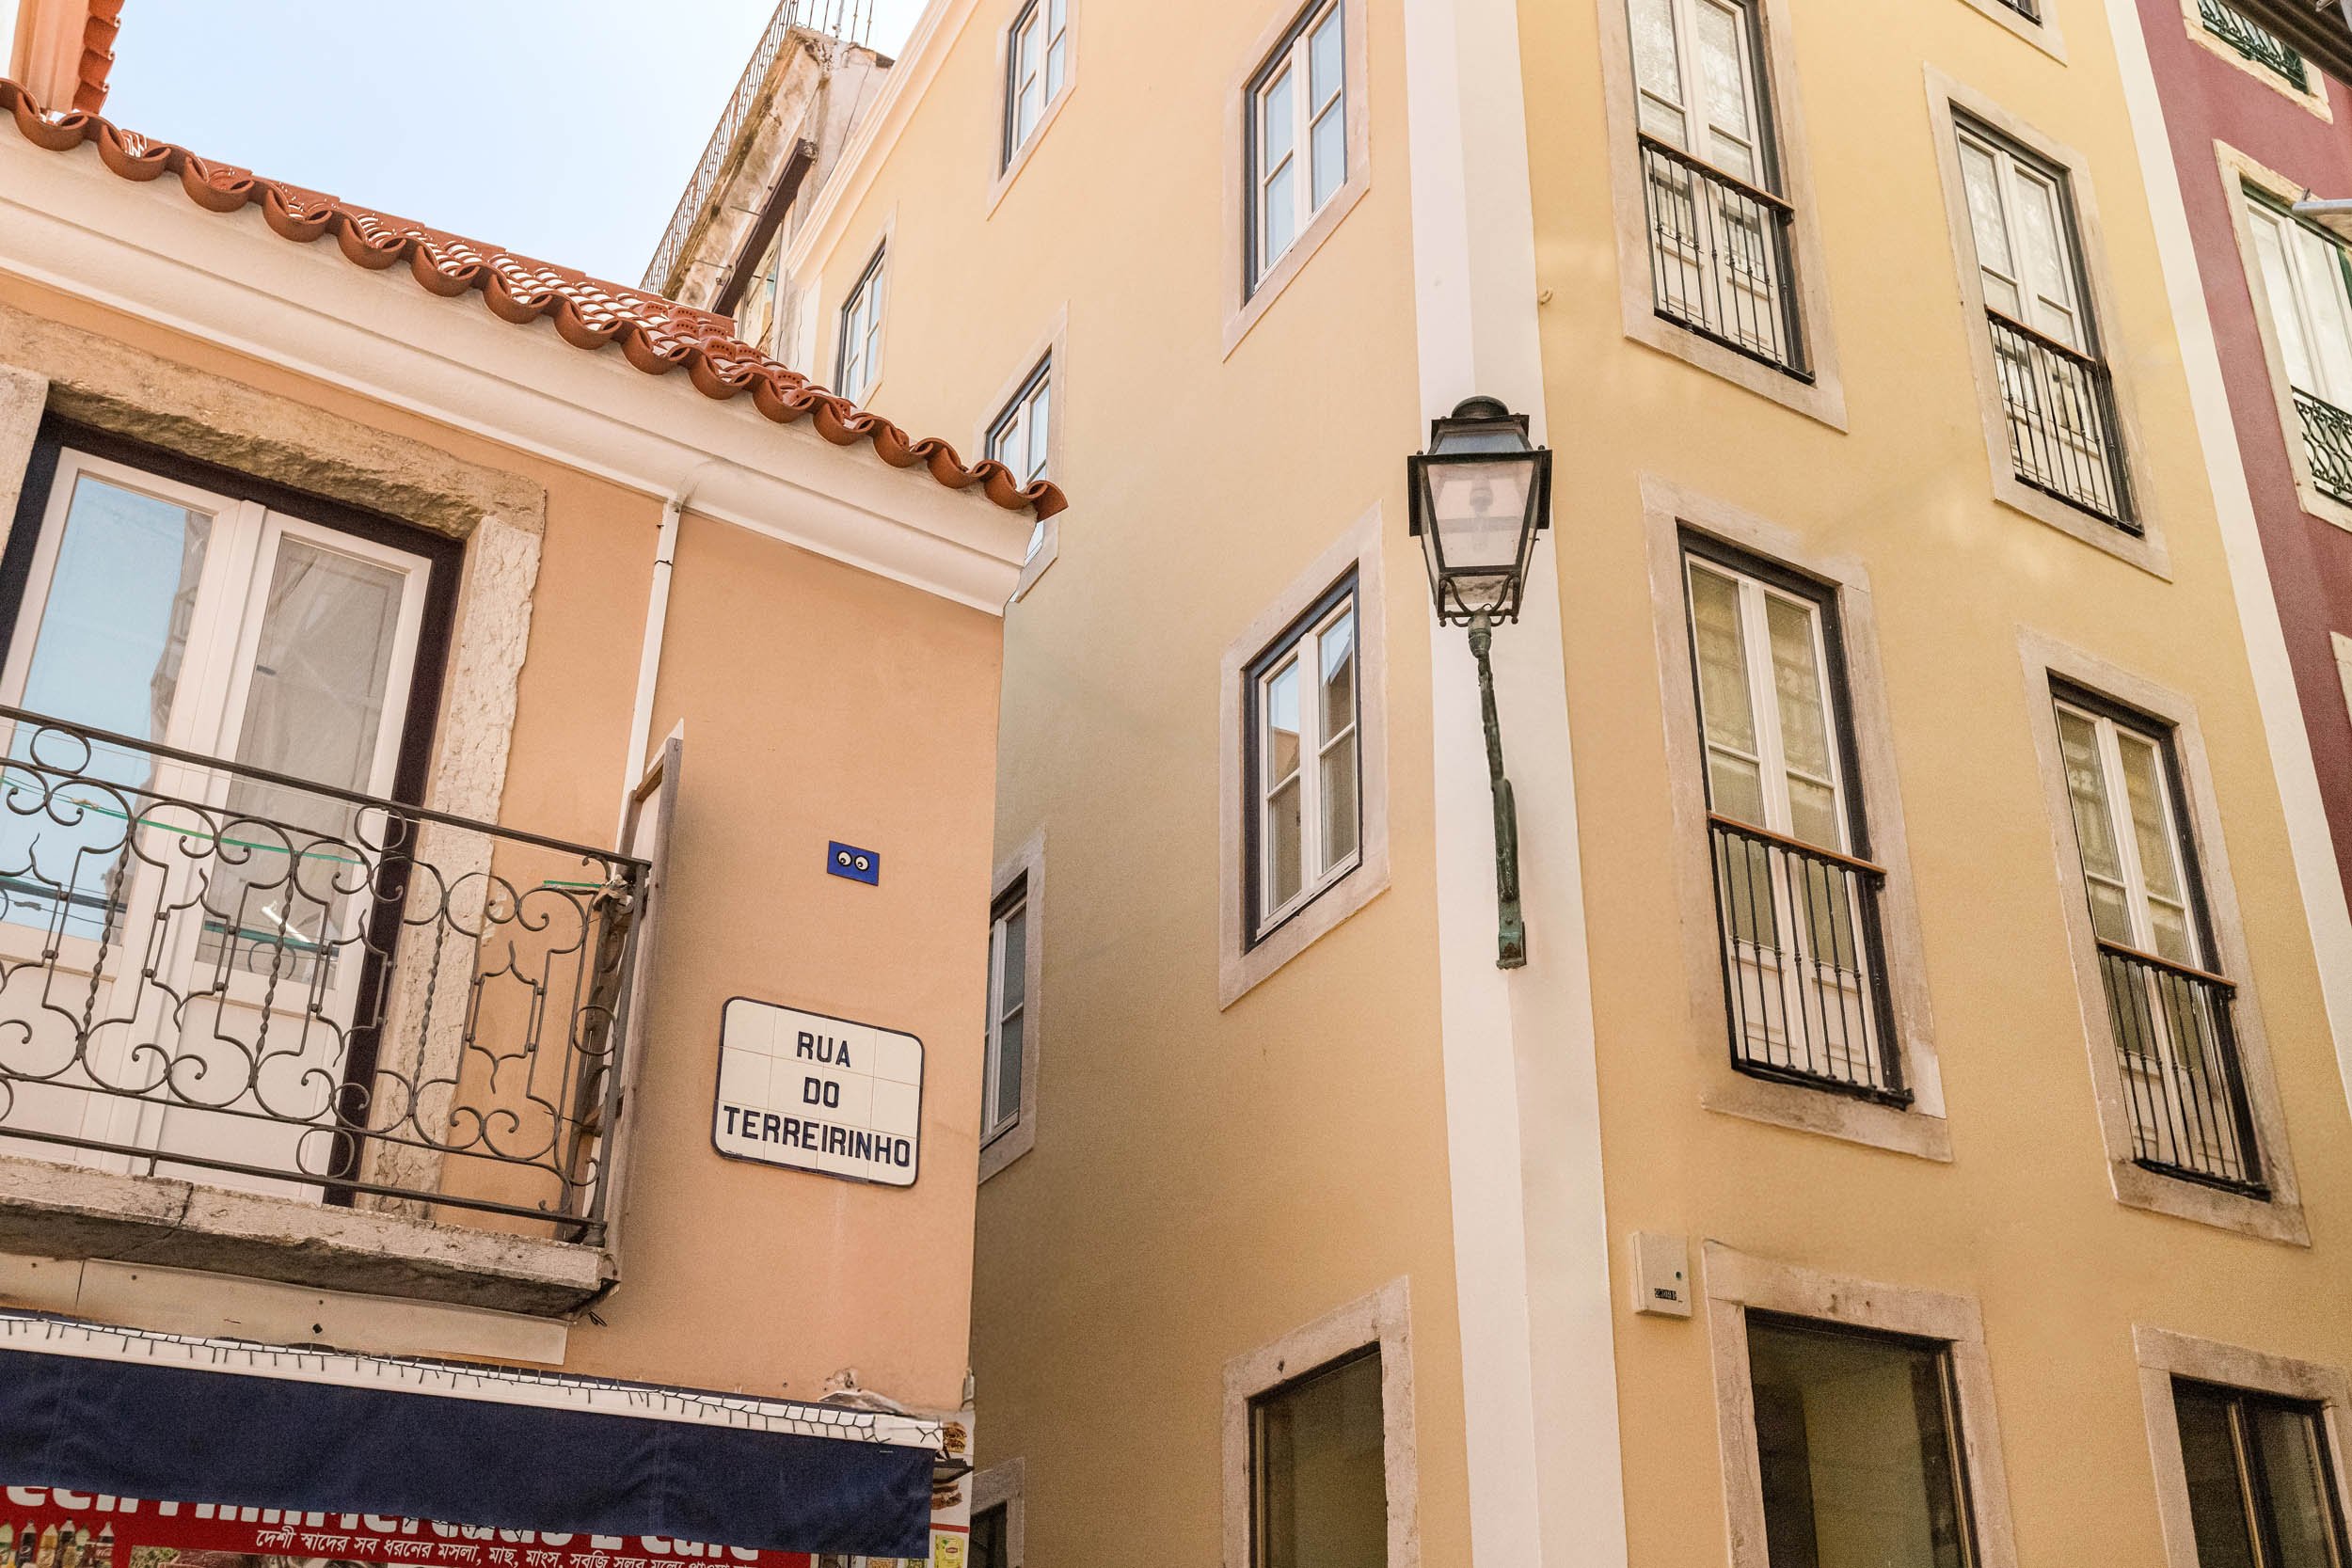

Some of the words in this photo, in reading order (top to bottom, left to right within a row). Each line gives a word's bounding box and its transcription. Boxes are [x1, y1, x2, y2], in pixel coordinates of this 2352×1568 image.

[796, 1030, 851, 1069] RUA
[803, 1076, 840, 1109] DO
[723, 1105, 911, 1167] TERREIRINHO
[255, 1525, 296, 1550] দেশী
[299, 1531, 351, 1554] স্বাদের
[353, 1536, 381, 1556] সব
[383, 1539, 435, 1559] ধরনের
